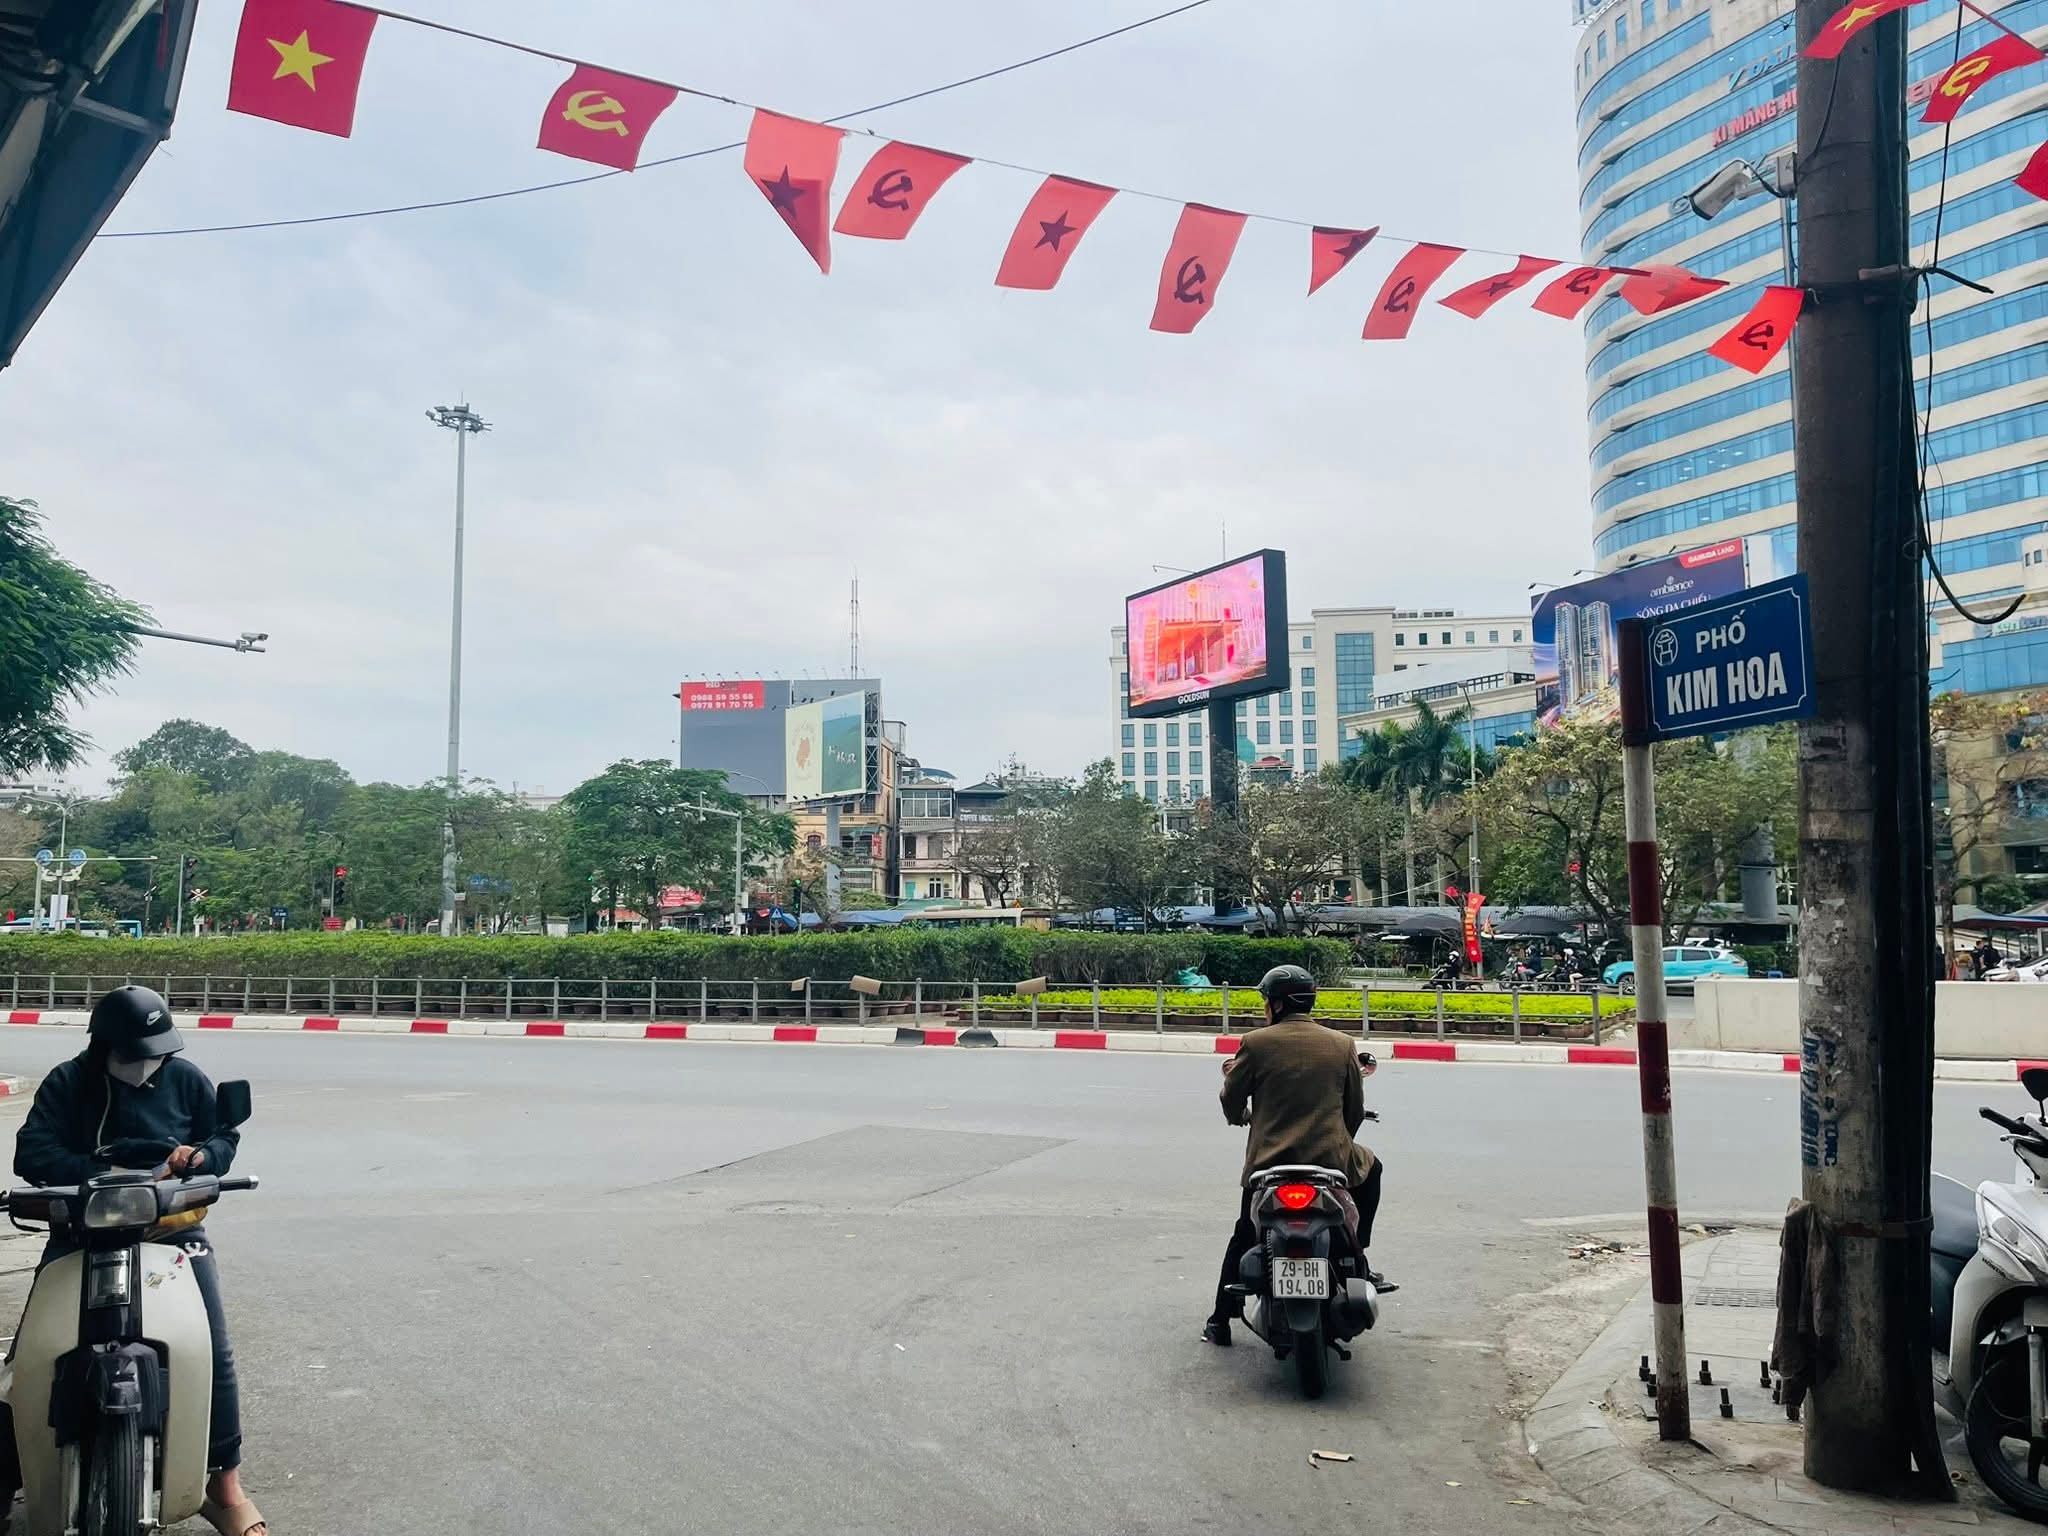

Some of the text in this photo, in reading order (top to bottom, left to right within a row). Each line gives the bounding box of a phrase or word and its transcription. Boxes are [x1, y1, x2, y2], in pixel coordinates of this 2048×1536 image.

[1716, 544, 1736, 557] LAND
[1650, 580, 1694, 598] ambience
[1695, 609, 1746, 654] PHỐ
[1666, 651, 1788, 716] KIM HOA
[1281, 1261, 1319, 1278] 29-BH
[1279, 1279, 1325, 1296] 194.08
